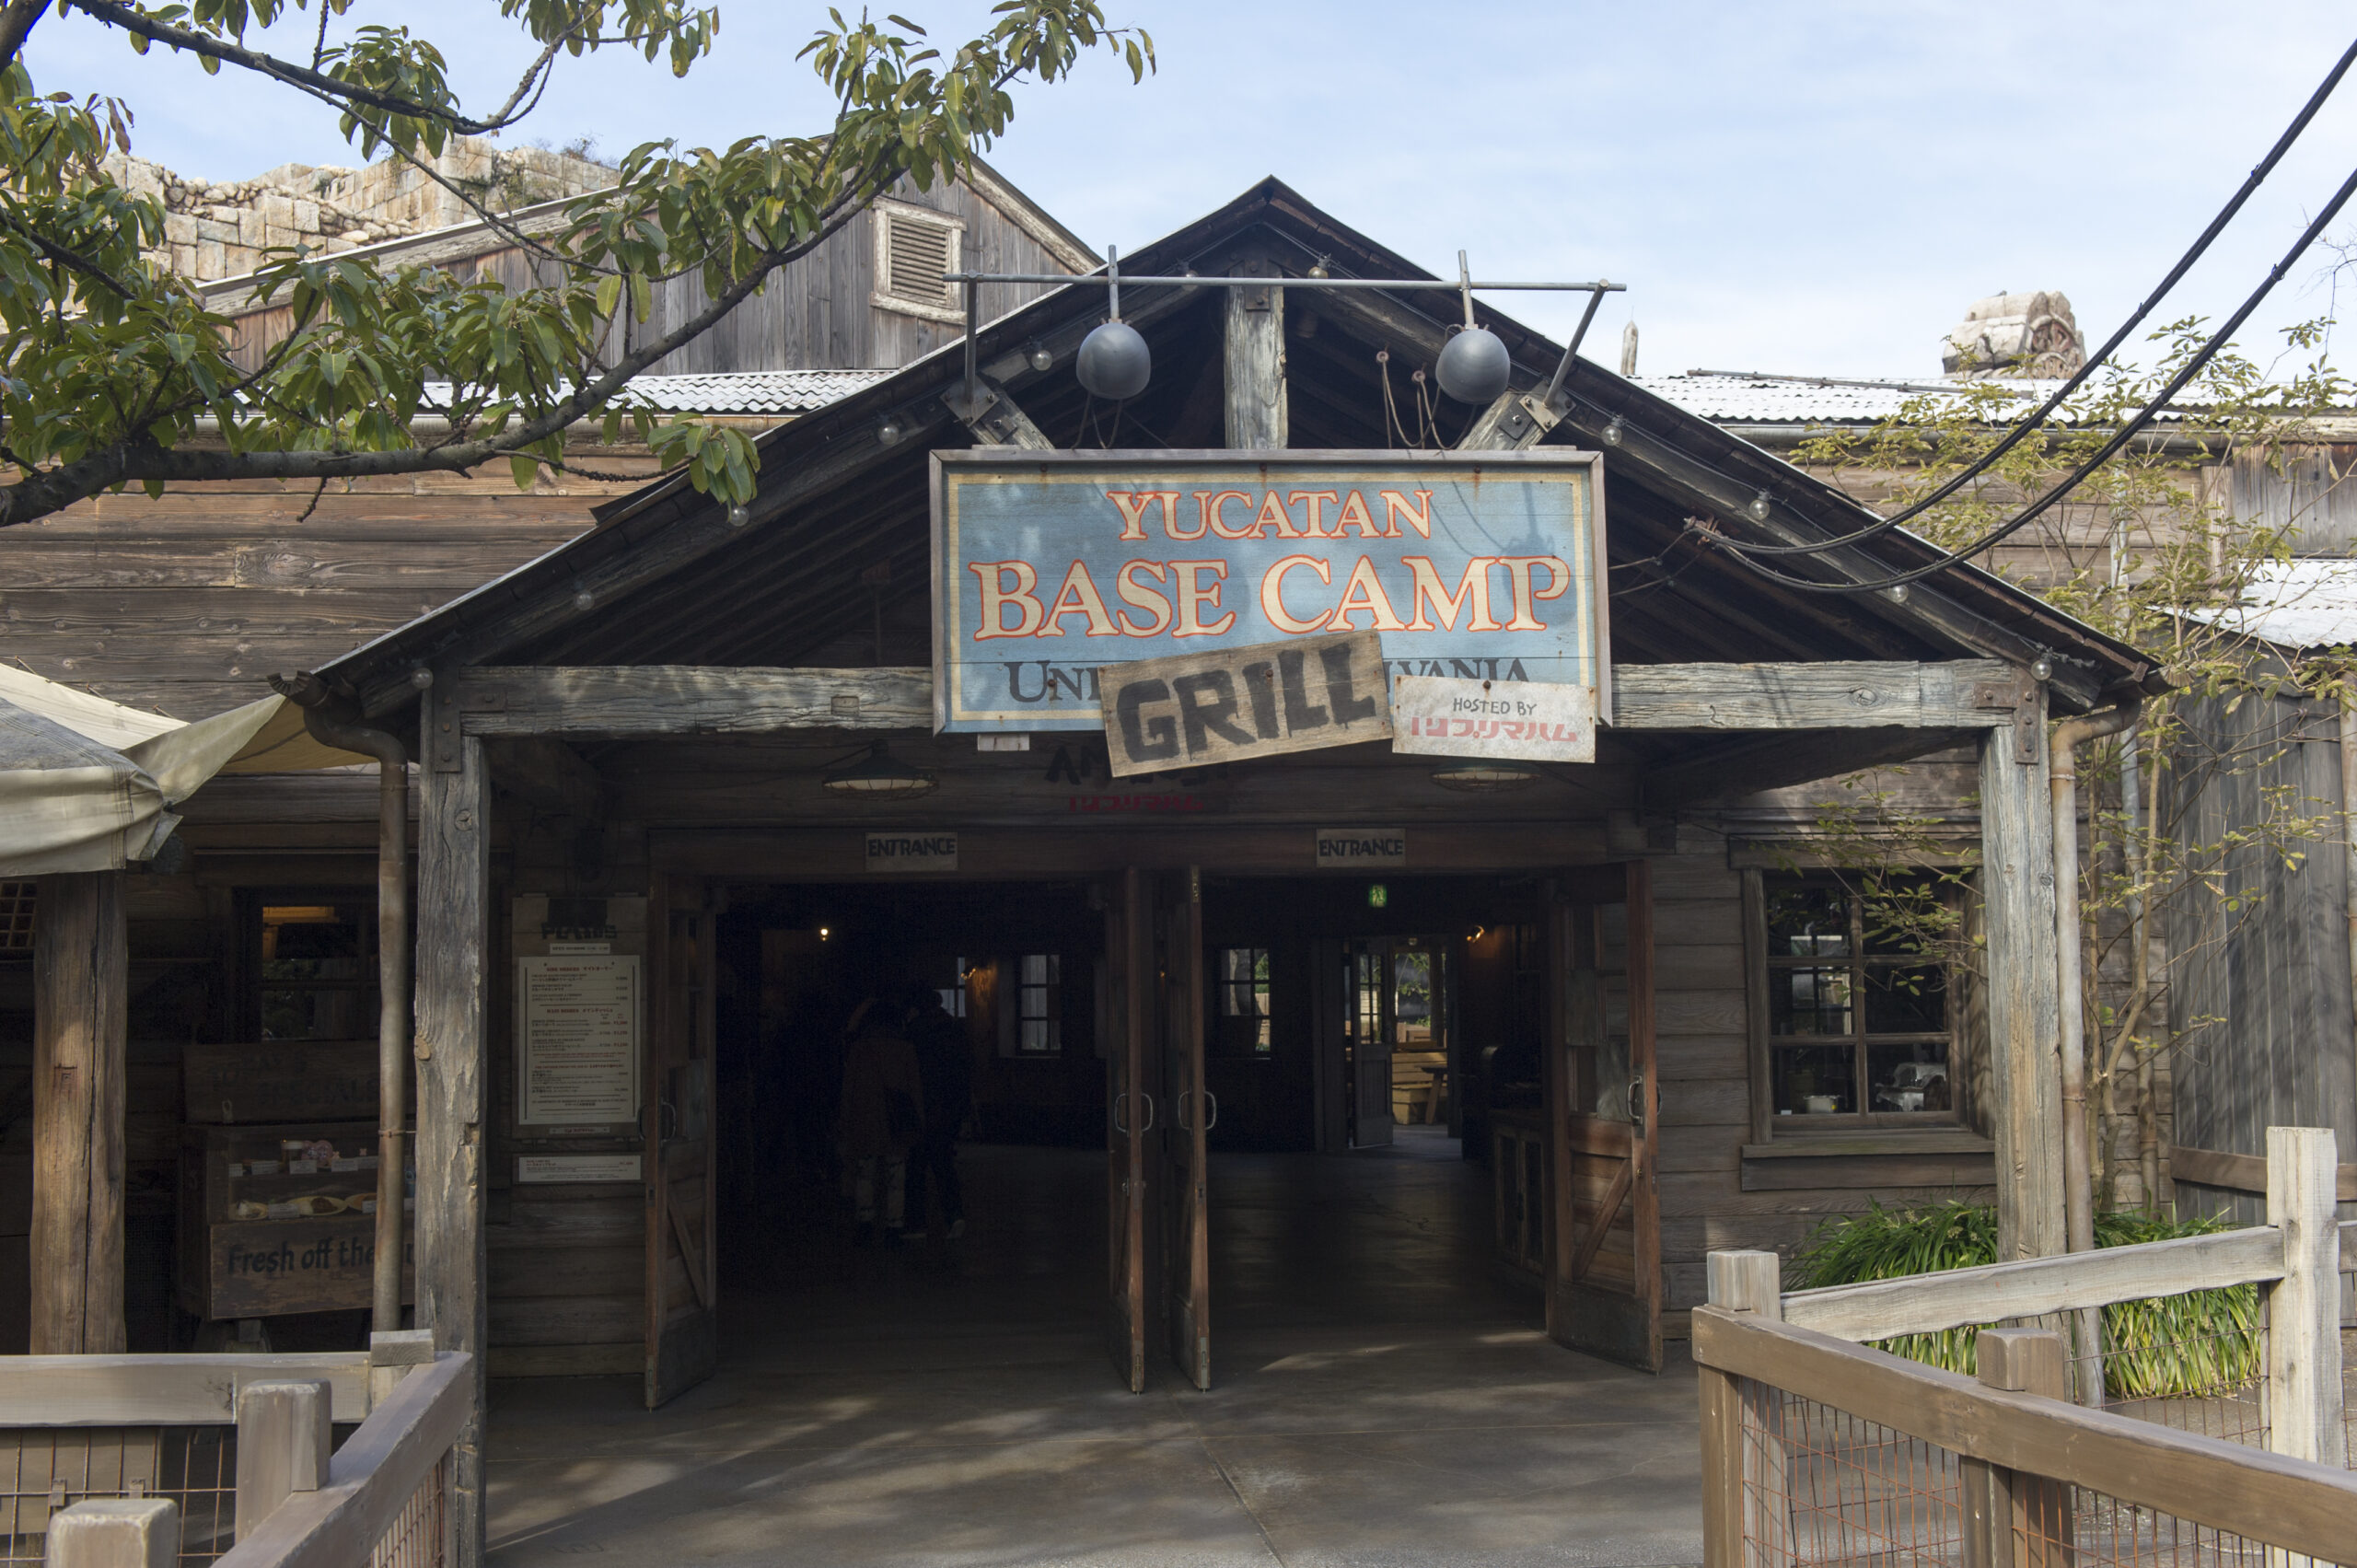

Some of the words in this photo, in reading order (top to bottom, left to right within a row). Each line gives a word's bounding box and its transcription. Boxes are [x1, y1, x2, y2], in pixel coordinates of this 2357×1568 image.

[1107, 489, 1433, 541] YUCATAN
[969, 558, 1237, 642] BASE
[1260, 554, 1571, 633] CAMP
[1004, 659, 1101, 703] UNI
[1116, 643, 1377, 763] GRILL
[1453, 697, 1511, 714] HOSTED
[1516, 702, 1538, 715] BY
[867, 837, 956, 857] ENTRANCE
[1318, 838, 1404, 856] ENTRANCE
[227, 1240, 295, 1275] Fresh
[301, 1236, 333, 1270] off
